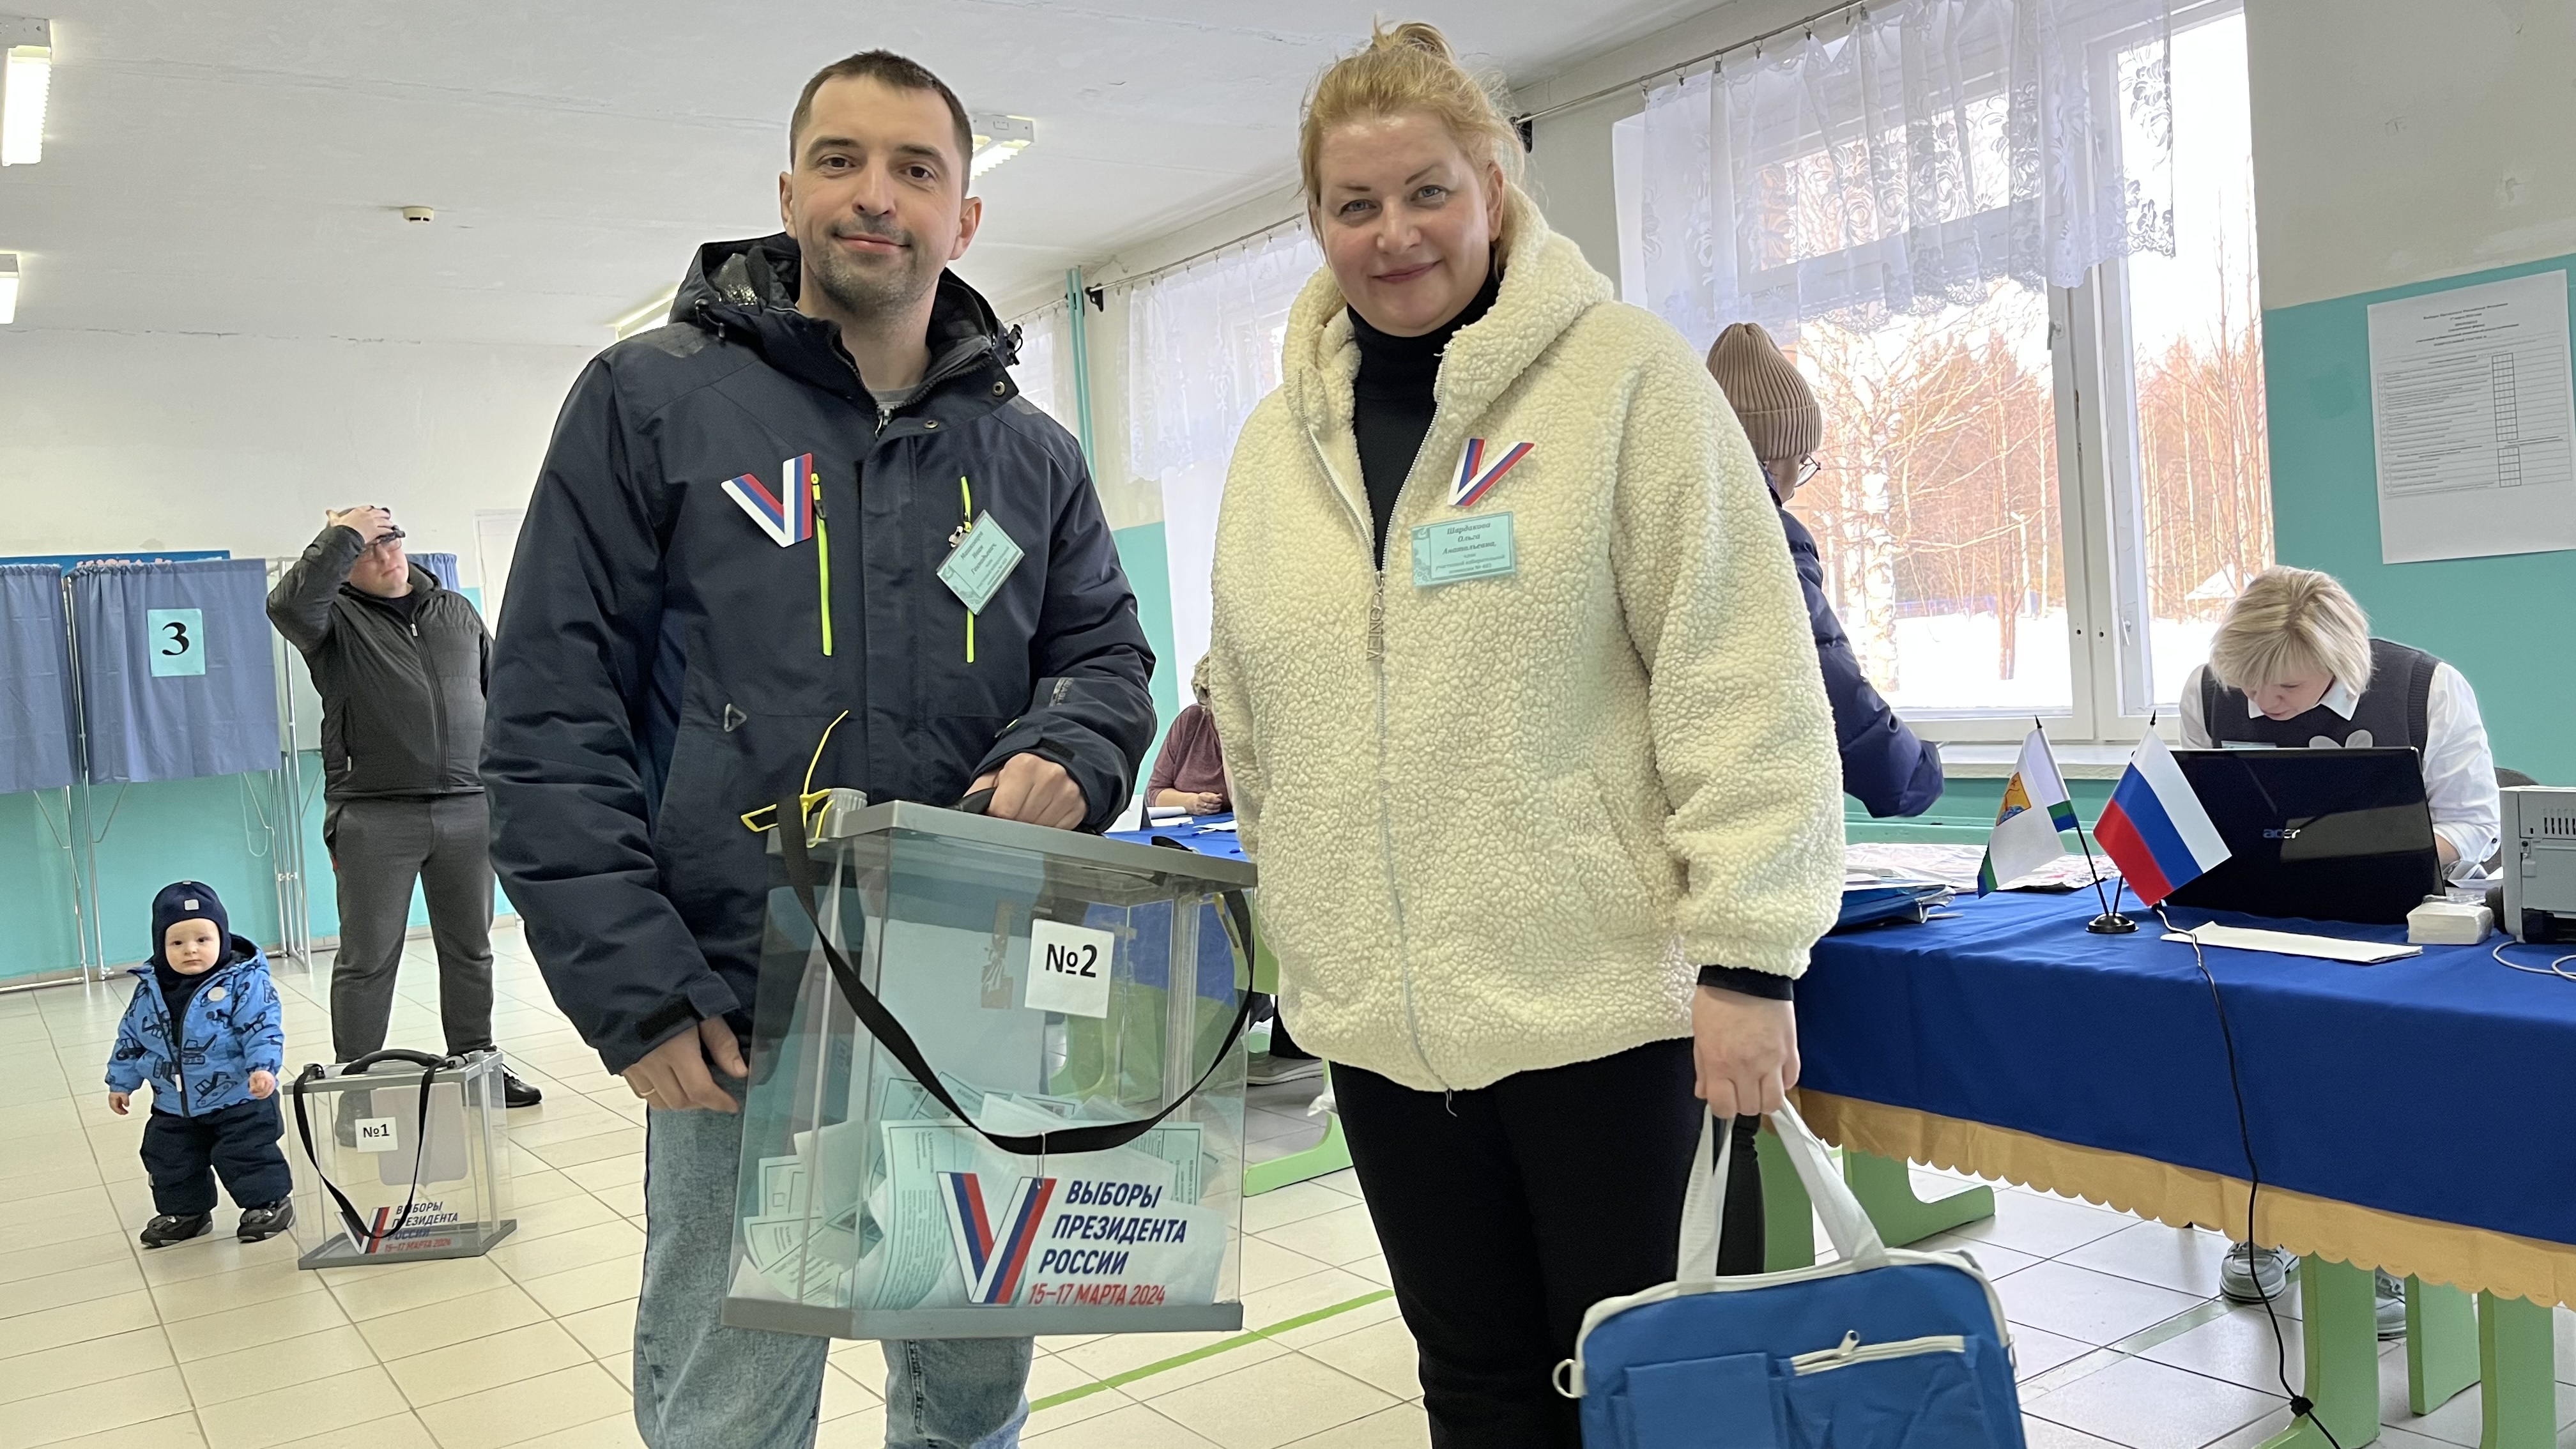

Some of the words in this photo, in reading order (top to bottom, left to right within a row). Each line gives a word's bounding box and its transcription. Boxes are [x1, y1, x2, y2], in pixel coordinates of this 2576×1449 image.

[1457, 534, 1480, 542] Ольга
[162, 622, 190, 656] 3
[2263, 829, 2301, 839] acer
[1045, 943, 1098, 978] №2
[363, 1123, 390, 1138] №1
[1064, 1180, 1163, 1209] ВЫБОРЫ
[396, 1201, 443, 1215] ВБОРЫ
[392, 1213, 458, 1228] ПЕЗИДЕНТА
[1052, 1214, 1188, 1245] ПРЕЗИДЕНТА
[1038, 1248, 1130, 1275] РОССИИ
[1075, 1284, 1128, 1305] МАРТА
[1129, 1285, 1165, 1306] 2024
